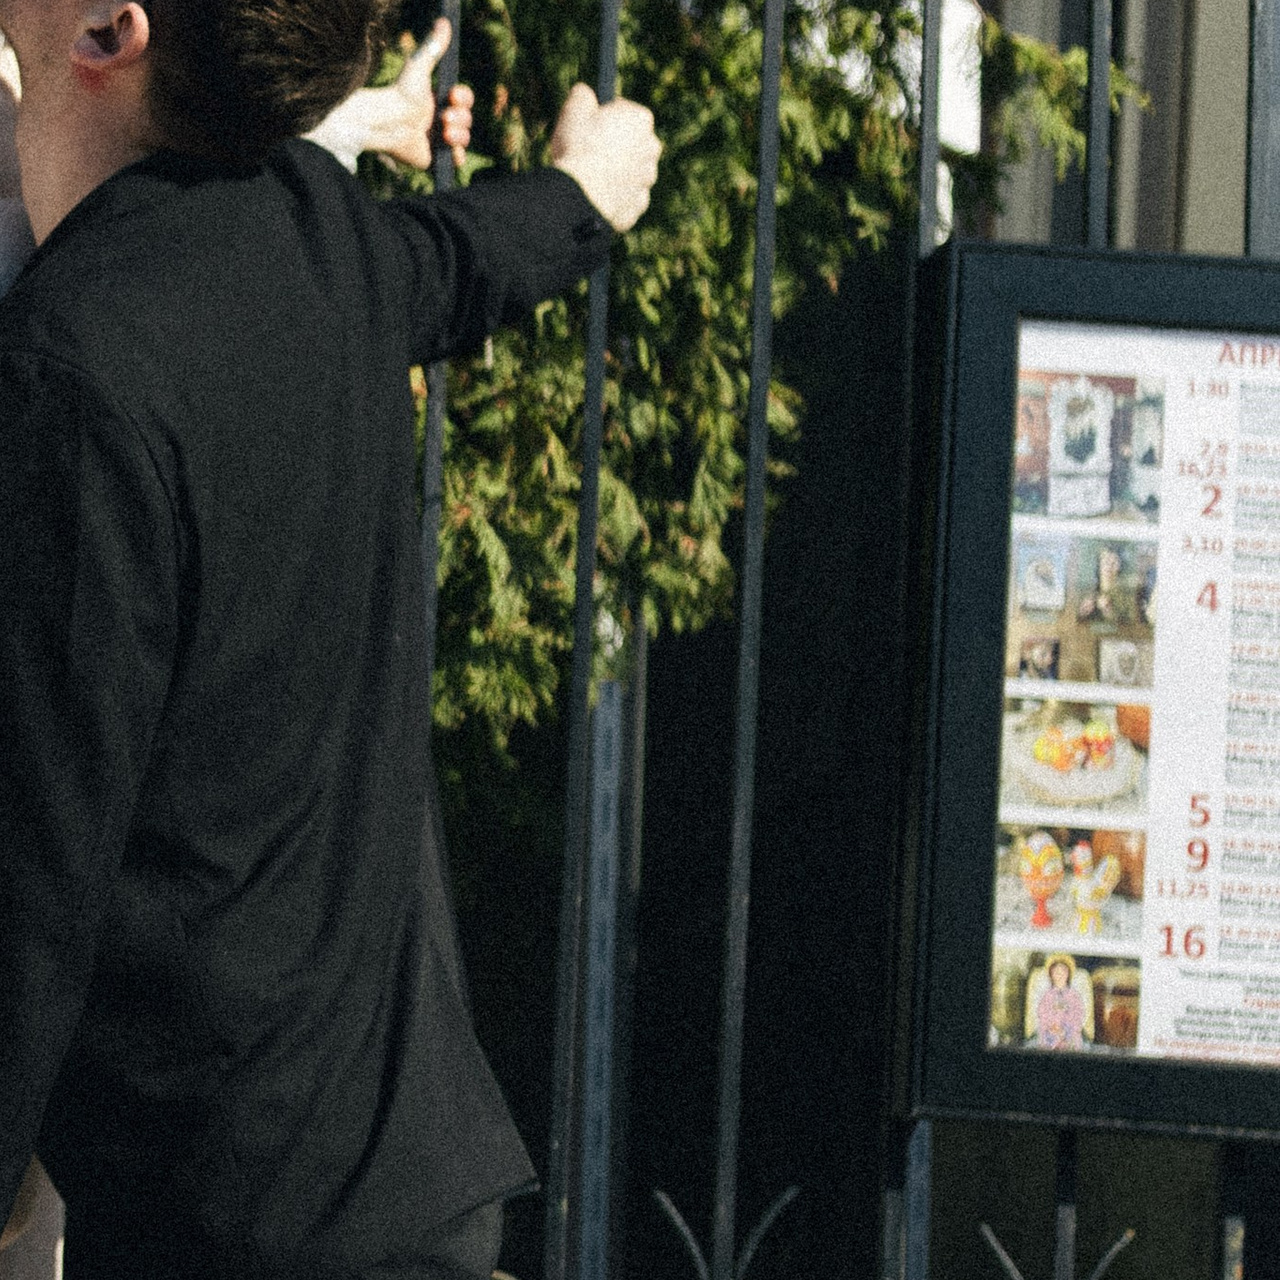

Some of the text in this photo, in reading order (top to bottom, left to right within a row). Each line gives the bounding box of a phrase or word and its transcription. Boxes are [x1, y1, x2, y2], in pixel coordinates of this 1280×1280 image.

[1201, 483, 1223, 518] 2
[1195, 579, 1220, 614] 4
[1188, 793, 1211, 829] 5
[1186, 836, 1211, 873] 9
[1158, 923, 1208, 960] 16
